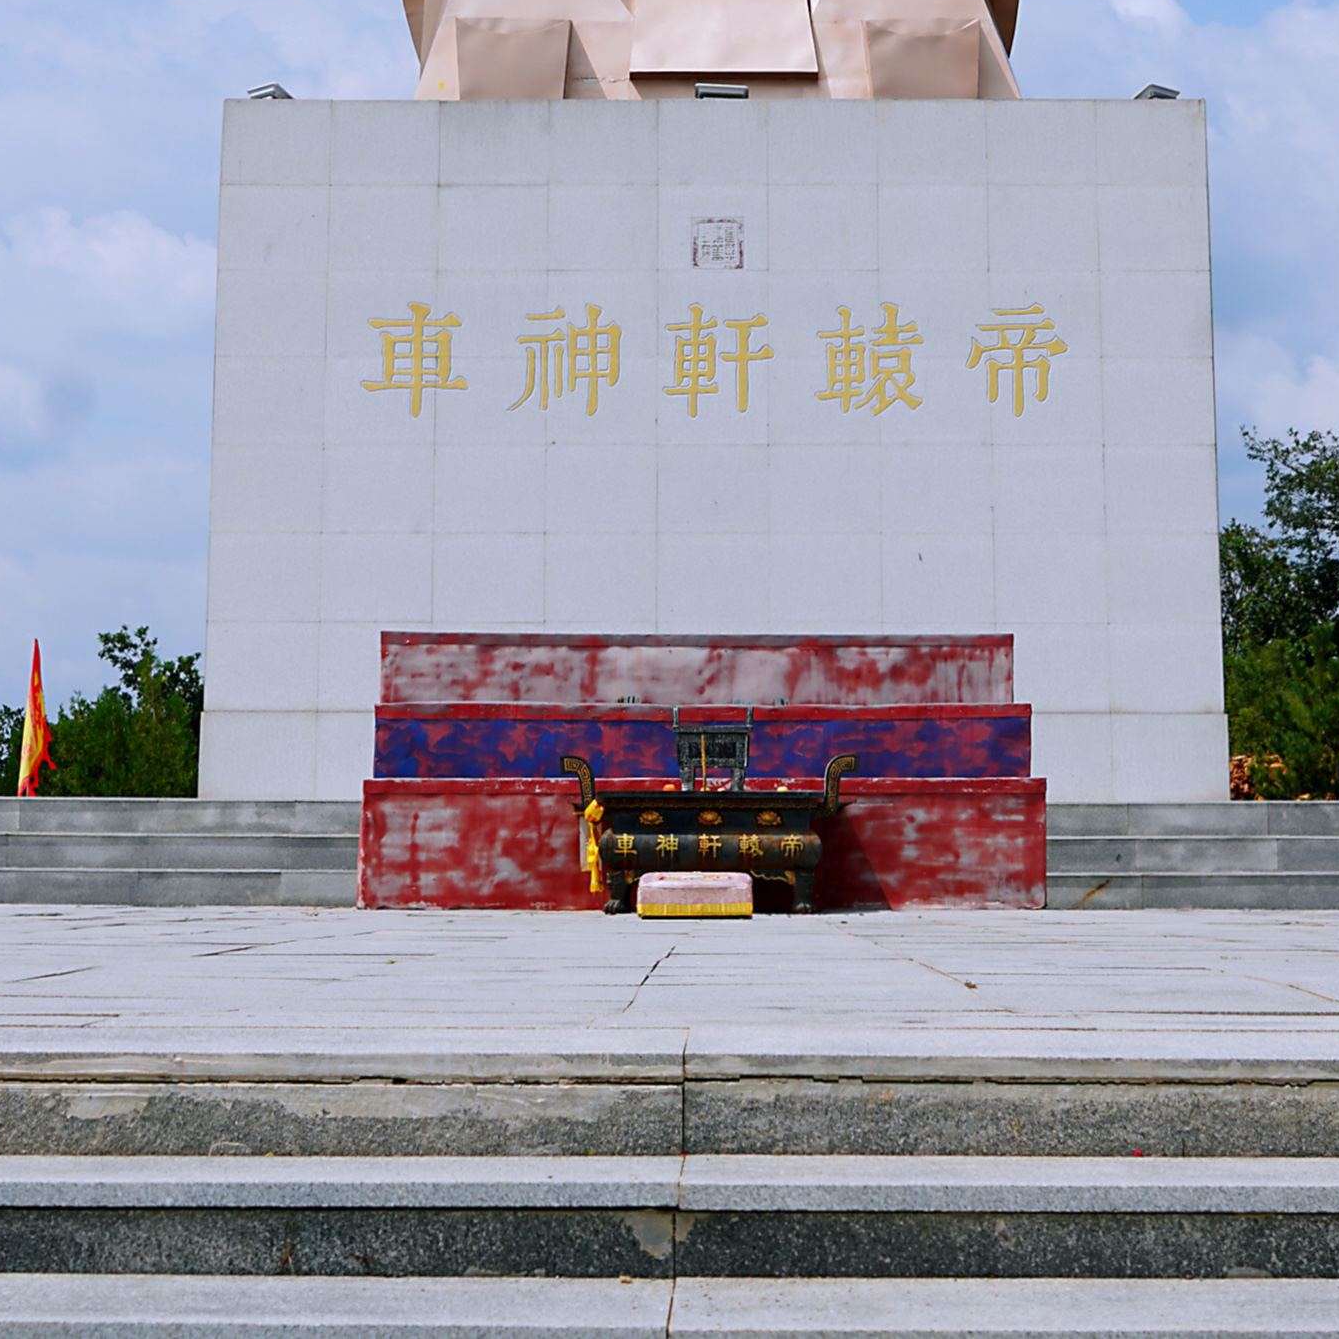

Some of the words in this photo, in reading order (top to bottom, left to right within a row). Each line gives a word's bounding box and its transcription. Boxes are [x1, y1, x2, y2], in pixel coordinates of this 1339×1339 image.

[362, 303, 1068, 417] 車神軒轅帝
[614, 833, 803, 858] 車神軒轅帝
